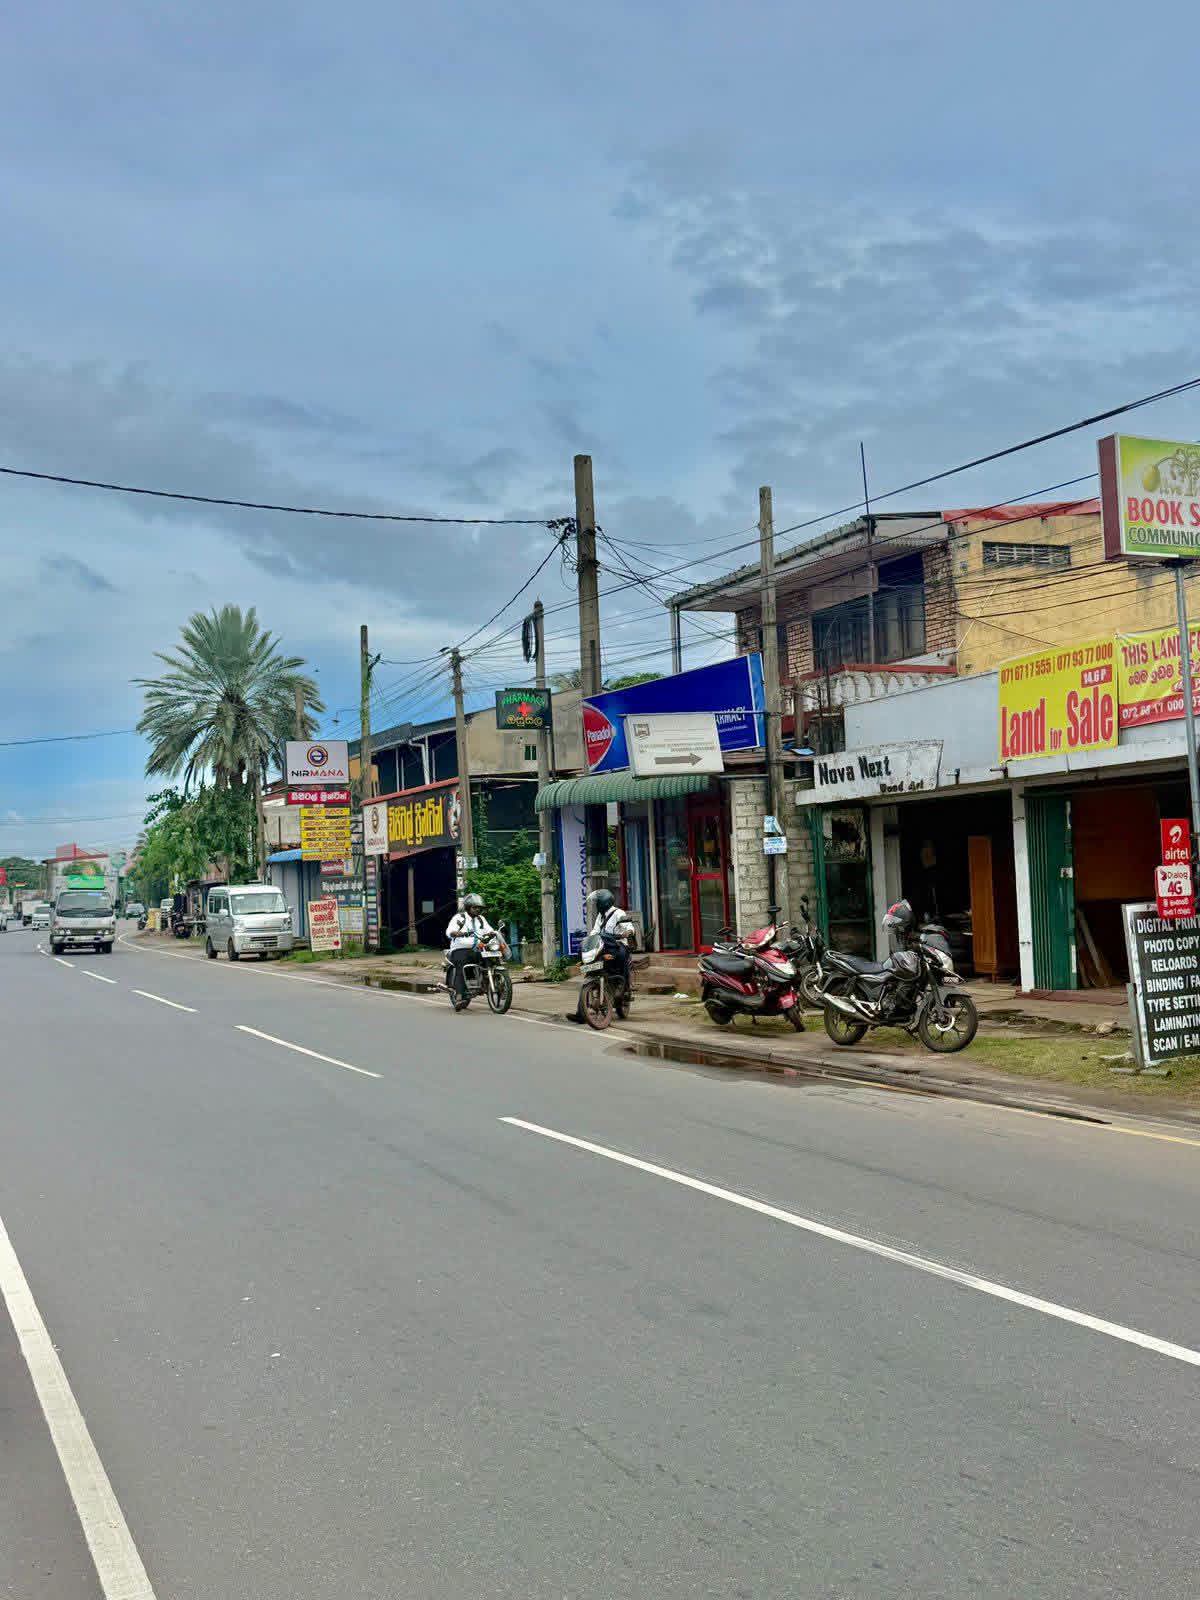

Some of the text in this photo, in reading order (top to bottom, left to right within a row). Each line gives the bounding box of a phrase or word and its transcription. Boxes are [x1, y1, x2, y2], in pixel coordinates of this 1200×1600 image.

[1127, 497, 1184, 525] BOOK
[1121, 642, 1148, 667] THIS
[1001, 686, 1113, 757] Land for Sale
[587, 725, 610, 742] Panadol
[291, 769, 344, 777] NIRMANA
[819, 756, 891, 786] Nova Next
[1165, 847, 1189, 860] airtel
[1167, 870, 1188, 880] Dialog
[1168, 881, 1182, 895] 4G
[1136, 917, 1174, 934] DIGITAL
[1144, 935, 1200, 953] PHOTO COPY
[1151, 955, 1198, 972] RELOARDS
[1146, 976, 1185, 993] BINDING
[1147, 997, 1170, 1012] TYPE
[1153, 1035, 1178, 1052] SCAN
